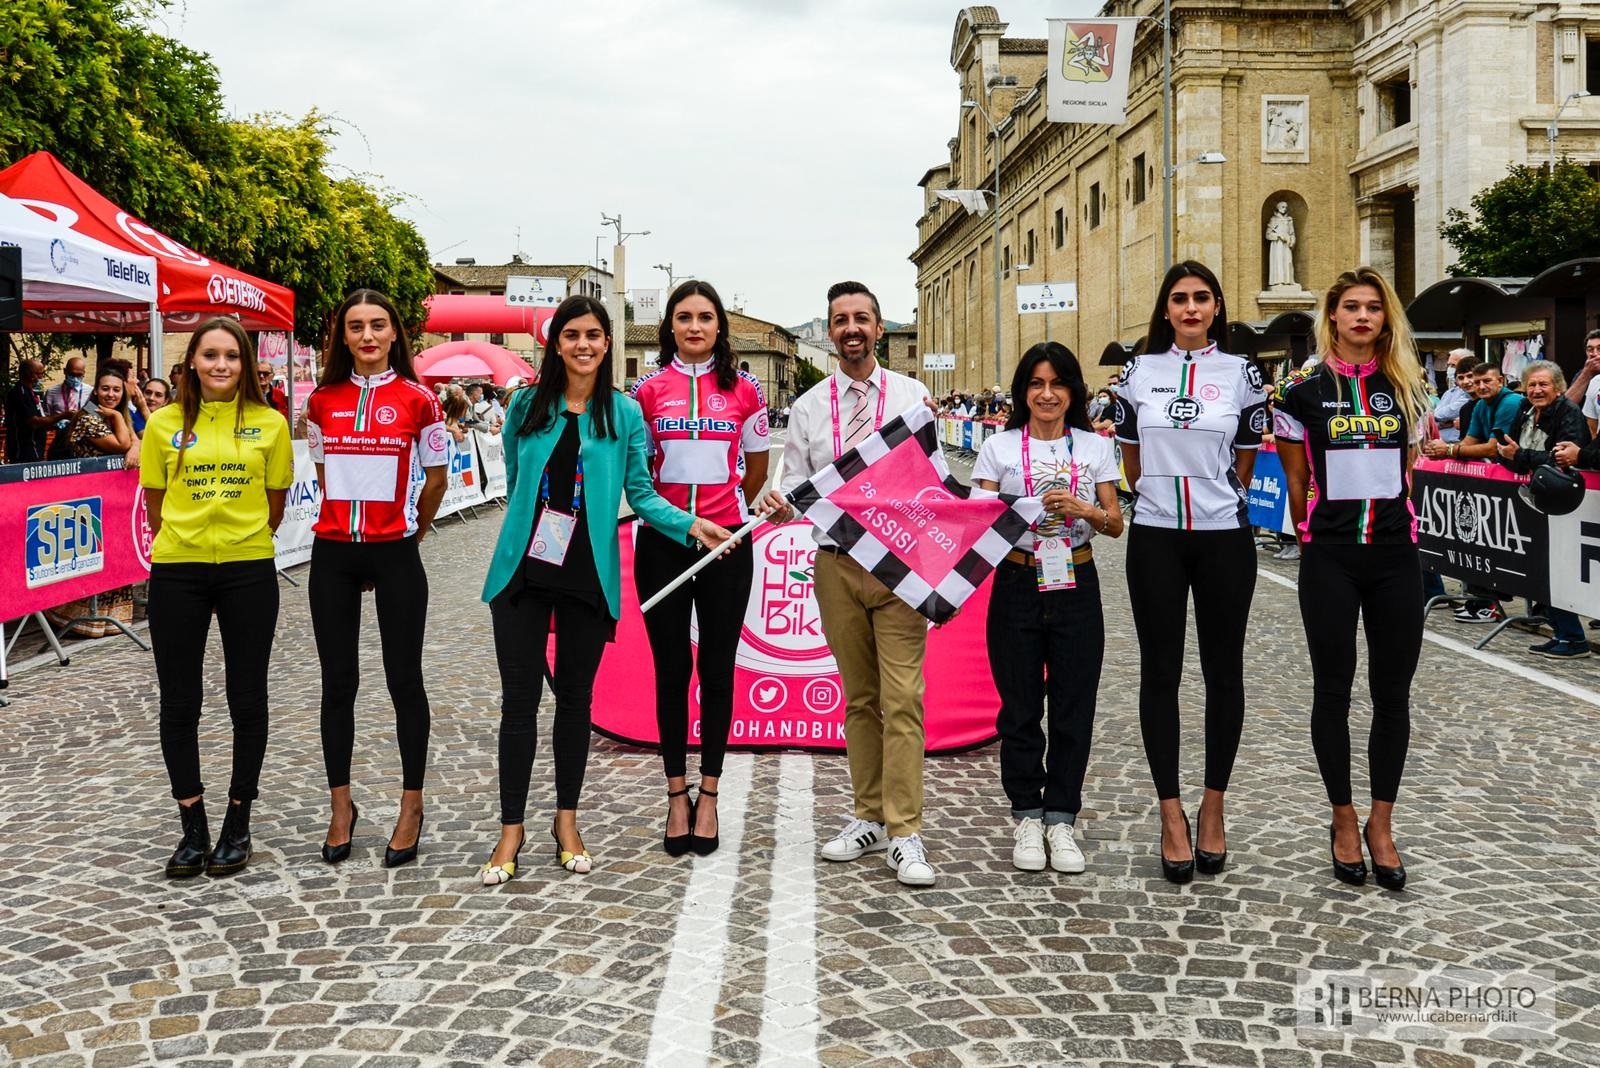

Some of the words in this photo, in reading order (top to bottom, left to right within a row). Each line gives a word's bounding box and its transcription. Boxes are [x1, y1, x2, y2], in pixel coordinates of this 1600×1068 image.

[104, 257, 151, 286] Teleflex
[655, 417, 737, 433] Teleflex
[1328, 415, 1400, 440] pmp
[342, 436, 377, 444] Marino
[23, 462, 81, 482] @GIROHANDBIKE
[1444, 463, 1486, 477] @GIROHANDBIKE
[859, 481, 877, 499] 26
[927, 526, 957, 554] 2021
[861, 506, 918, 554] ASSISI
[38, 504, 93, 565] SEO
[1447, 549, 1491, 574] WINES
